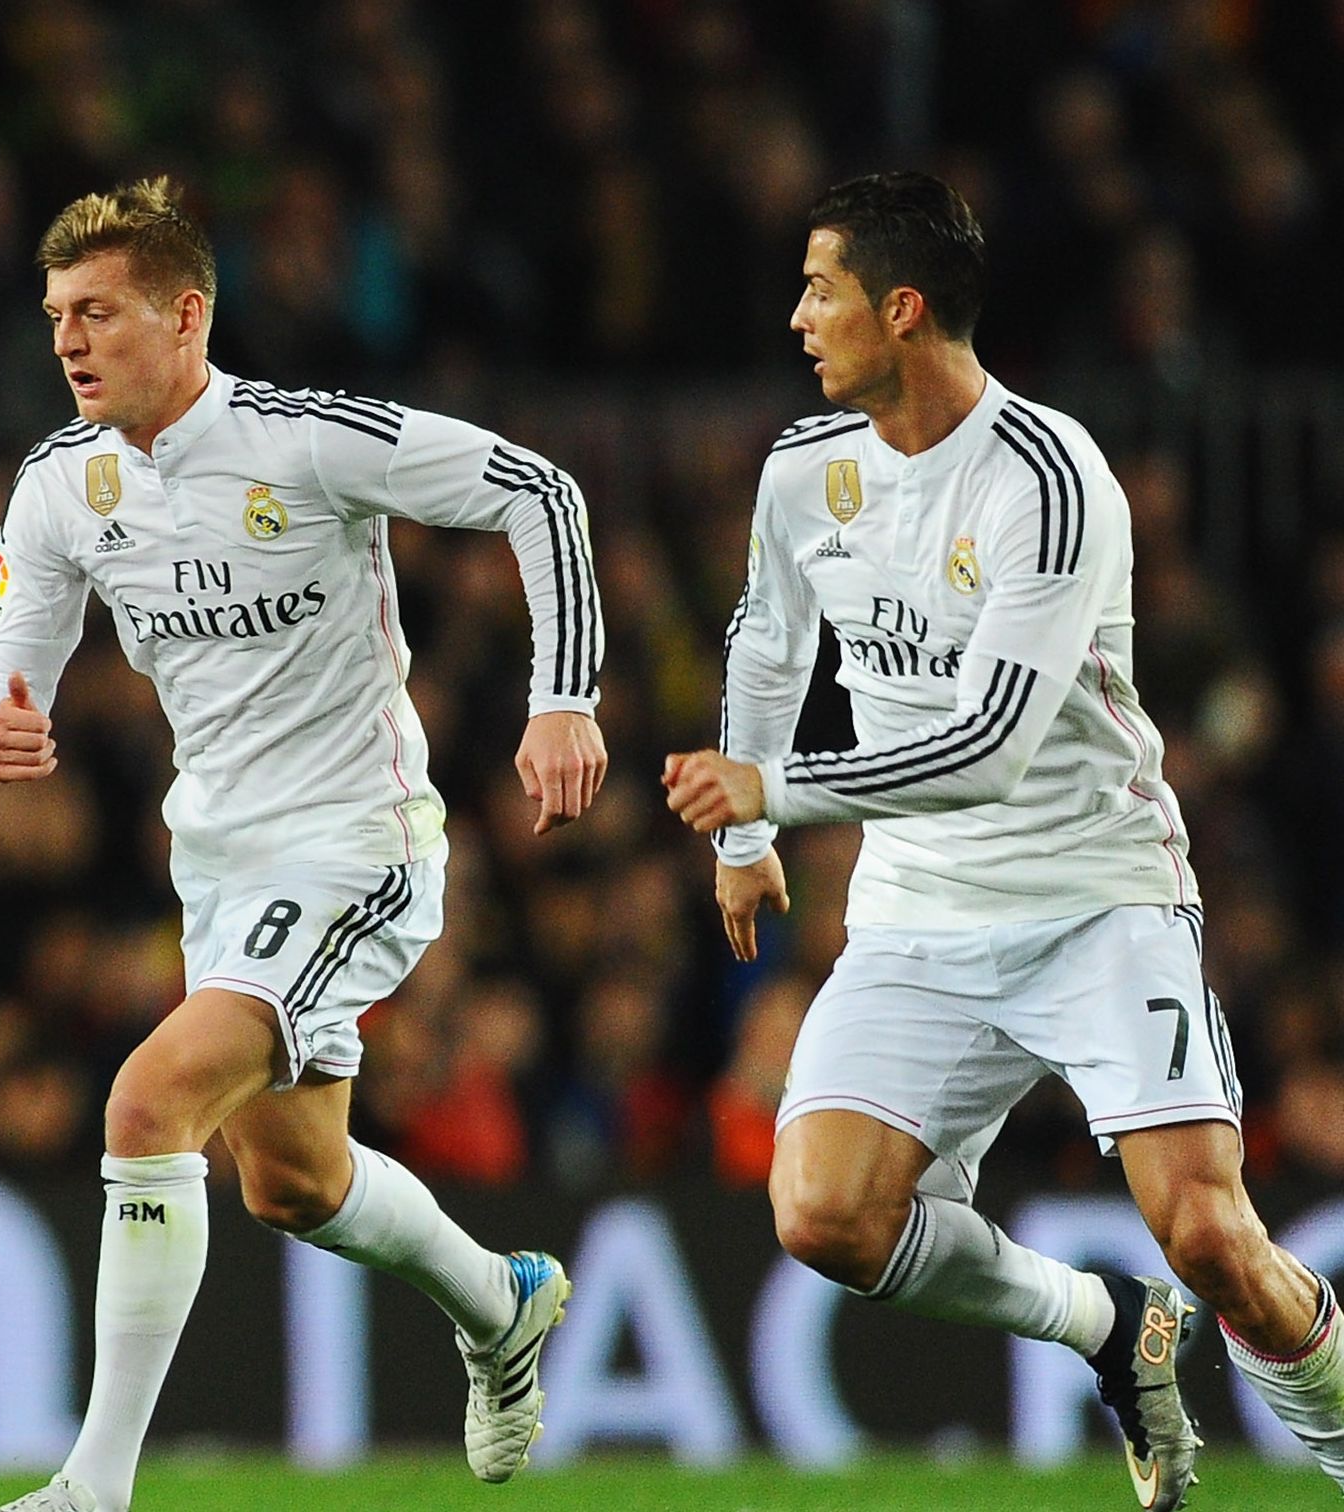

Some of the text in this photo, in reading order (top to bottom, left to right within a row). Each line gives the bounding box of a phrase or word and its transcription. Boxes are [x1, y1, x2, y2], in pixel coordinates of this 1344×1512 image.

[95, 538, 136, 553] adidas
[172, 559, 231, 595] Fly
[124, 580, 327, 643] Emirates
[871, 596, 928, 643] Fly
[243, 899, 303, 960] 8
[1146, 997, 1190, 1081] 7
[118, 1201, 166, 1225] RM
